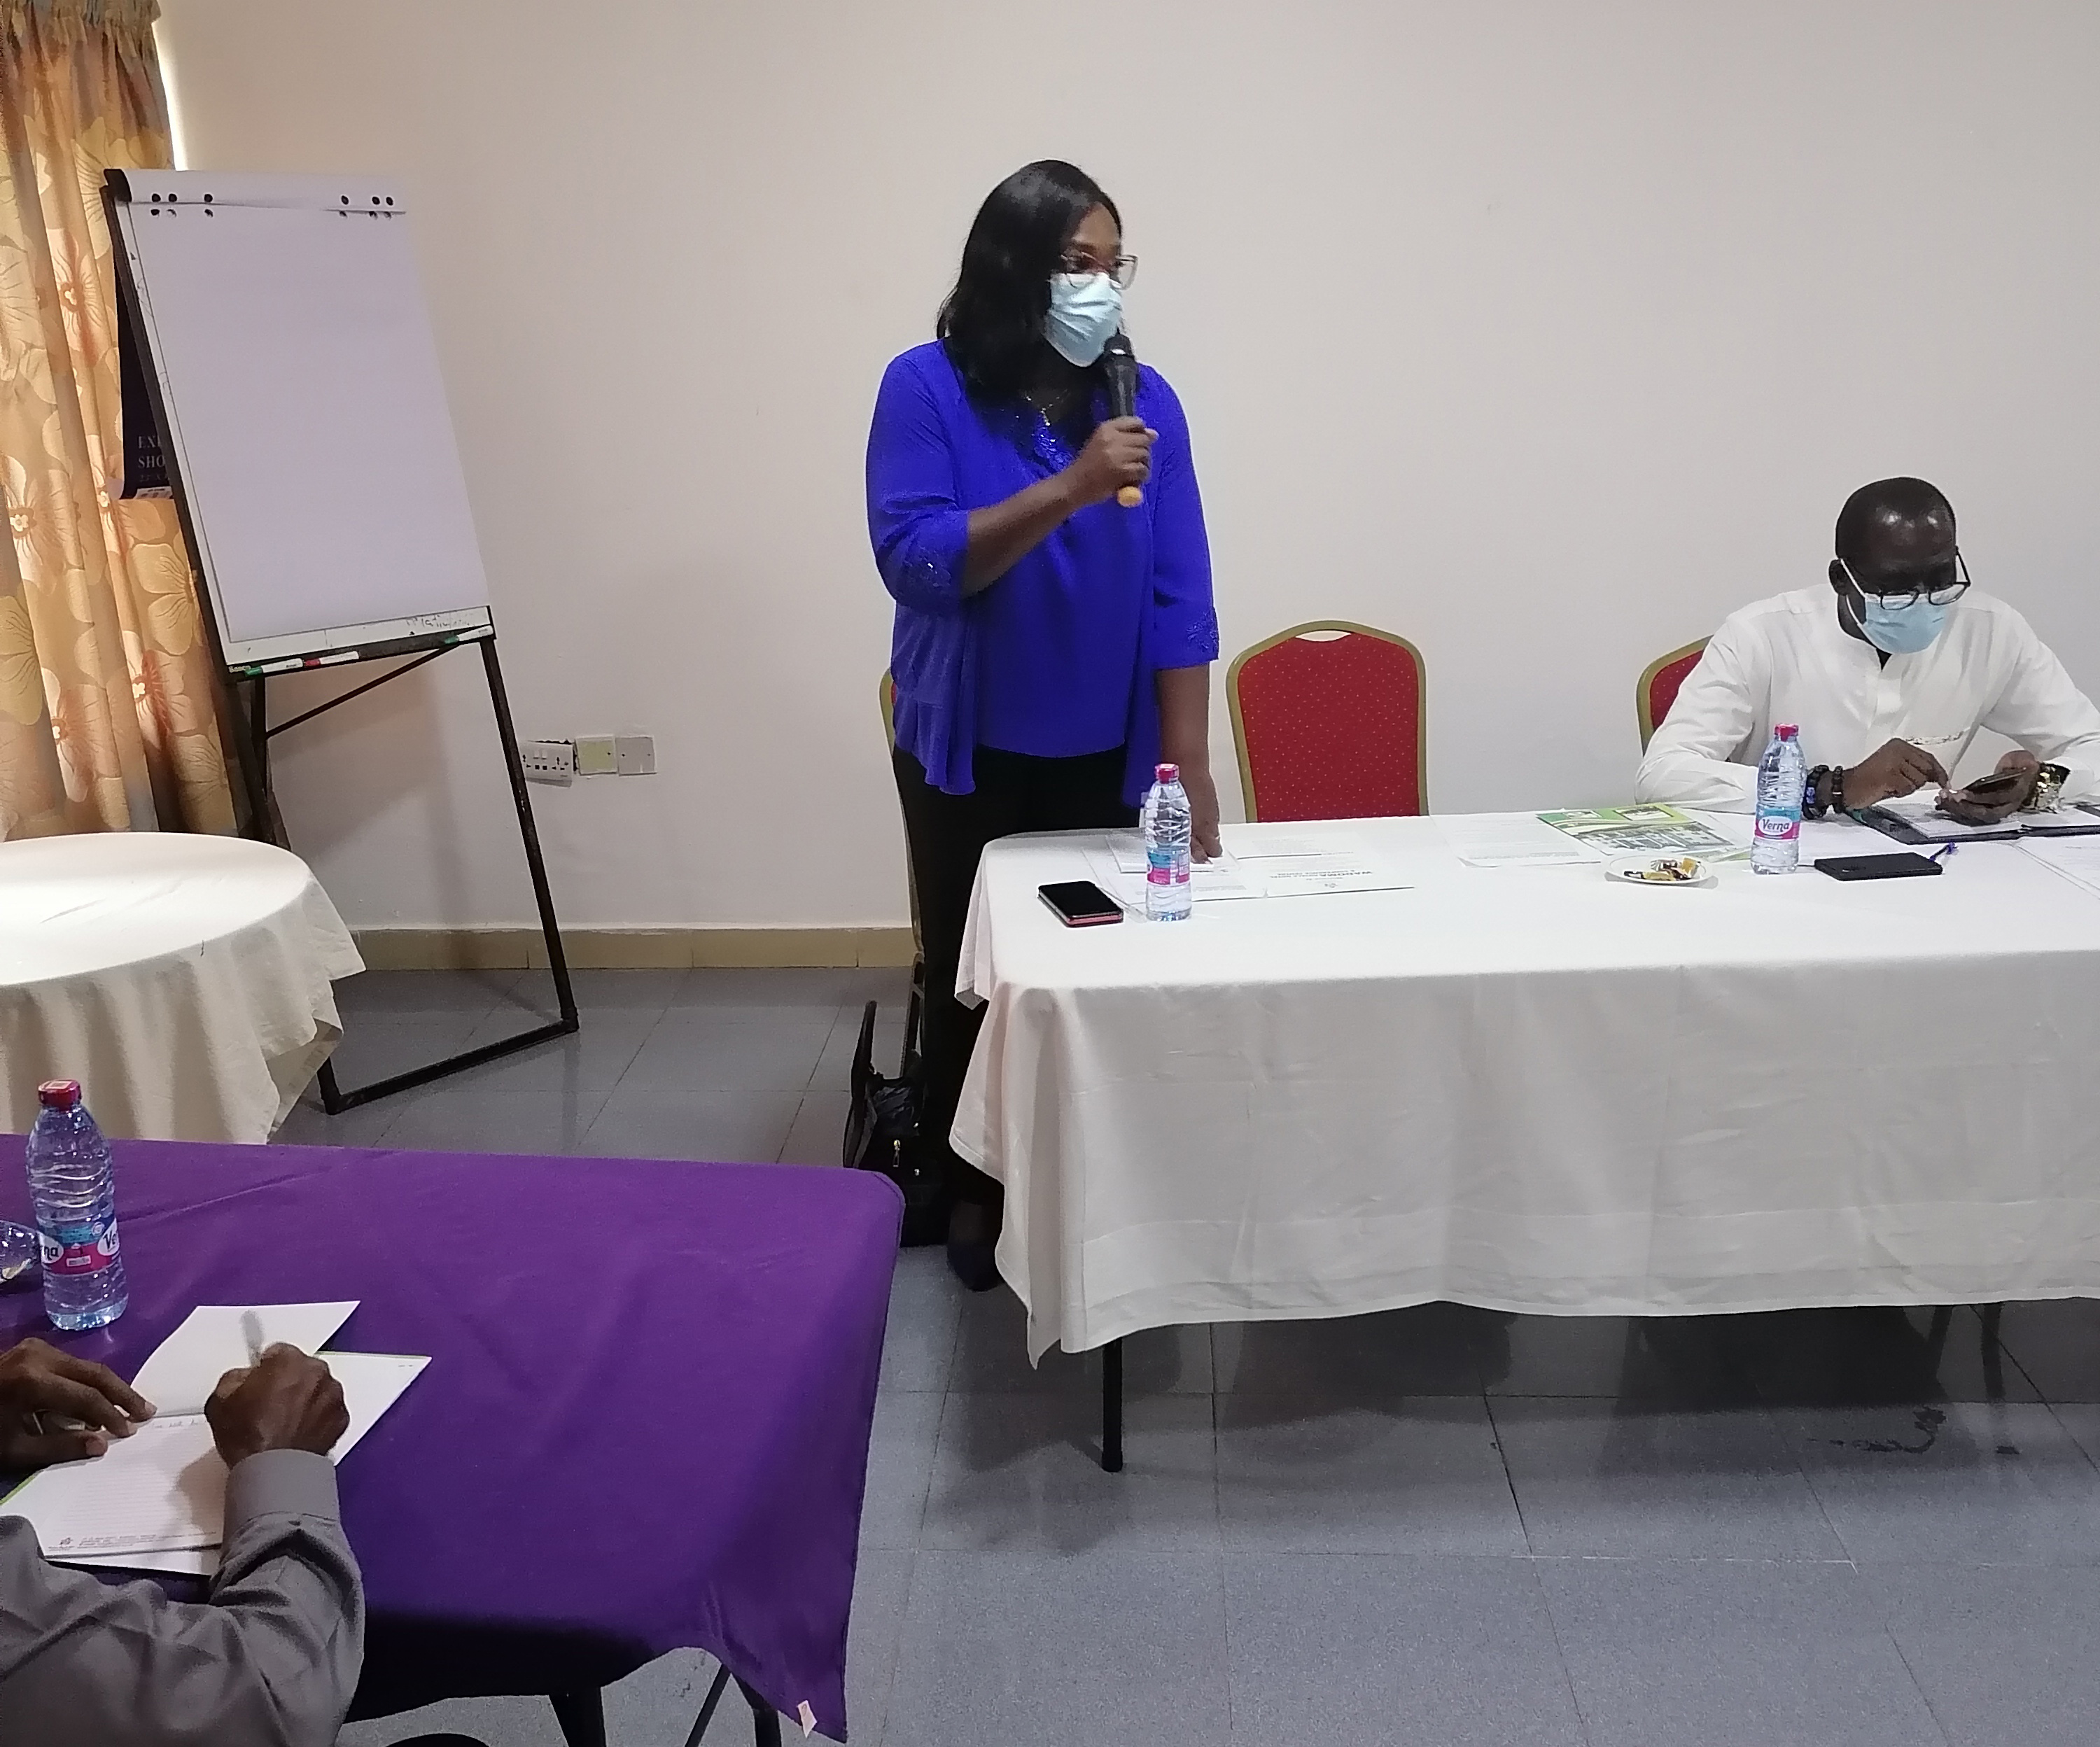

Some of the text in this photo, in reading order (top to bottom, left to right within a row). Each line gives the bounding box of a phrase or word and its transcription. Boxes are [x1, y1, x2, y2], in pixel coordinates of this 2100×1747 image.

[138, 435, 160, 448] EX
[138, 455, 166, 468] SHO
[1762, 818, 1790, 832] Verna
[103, 1230, 117, 1251] Ve
